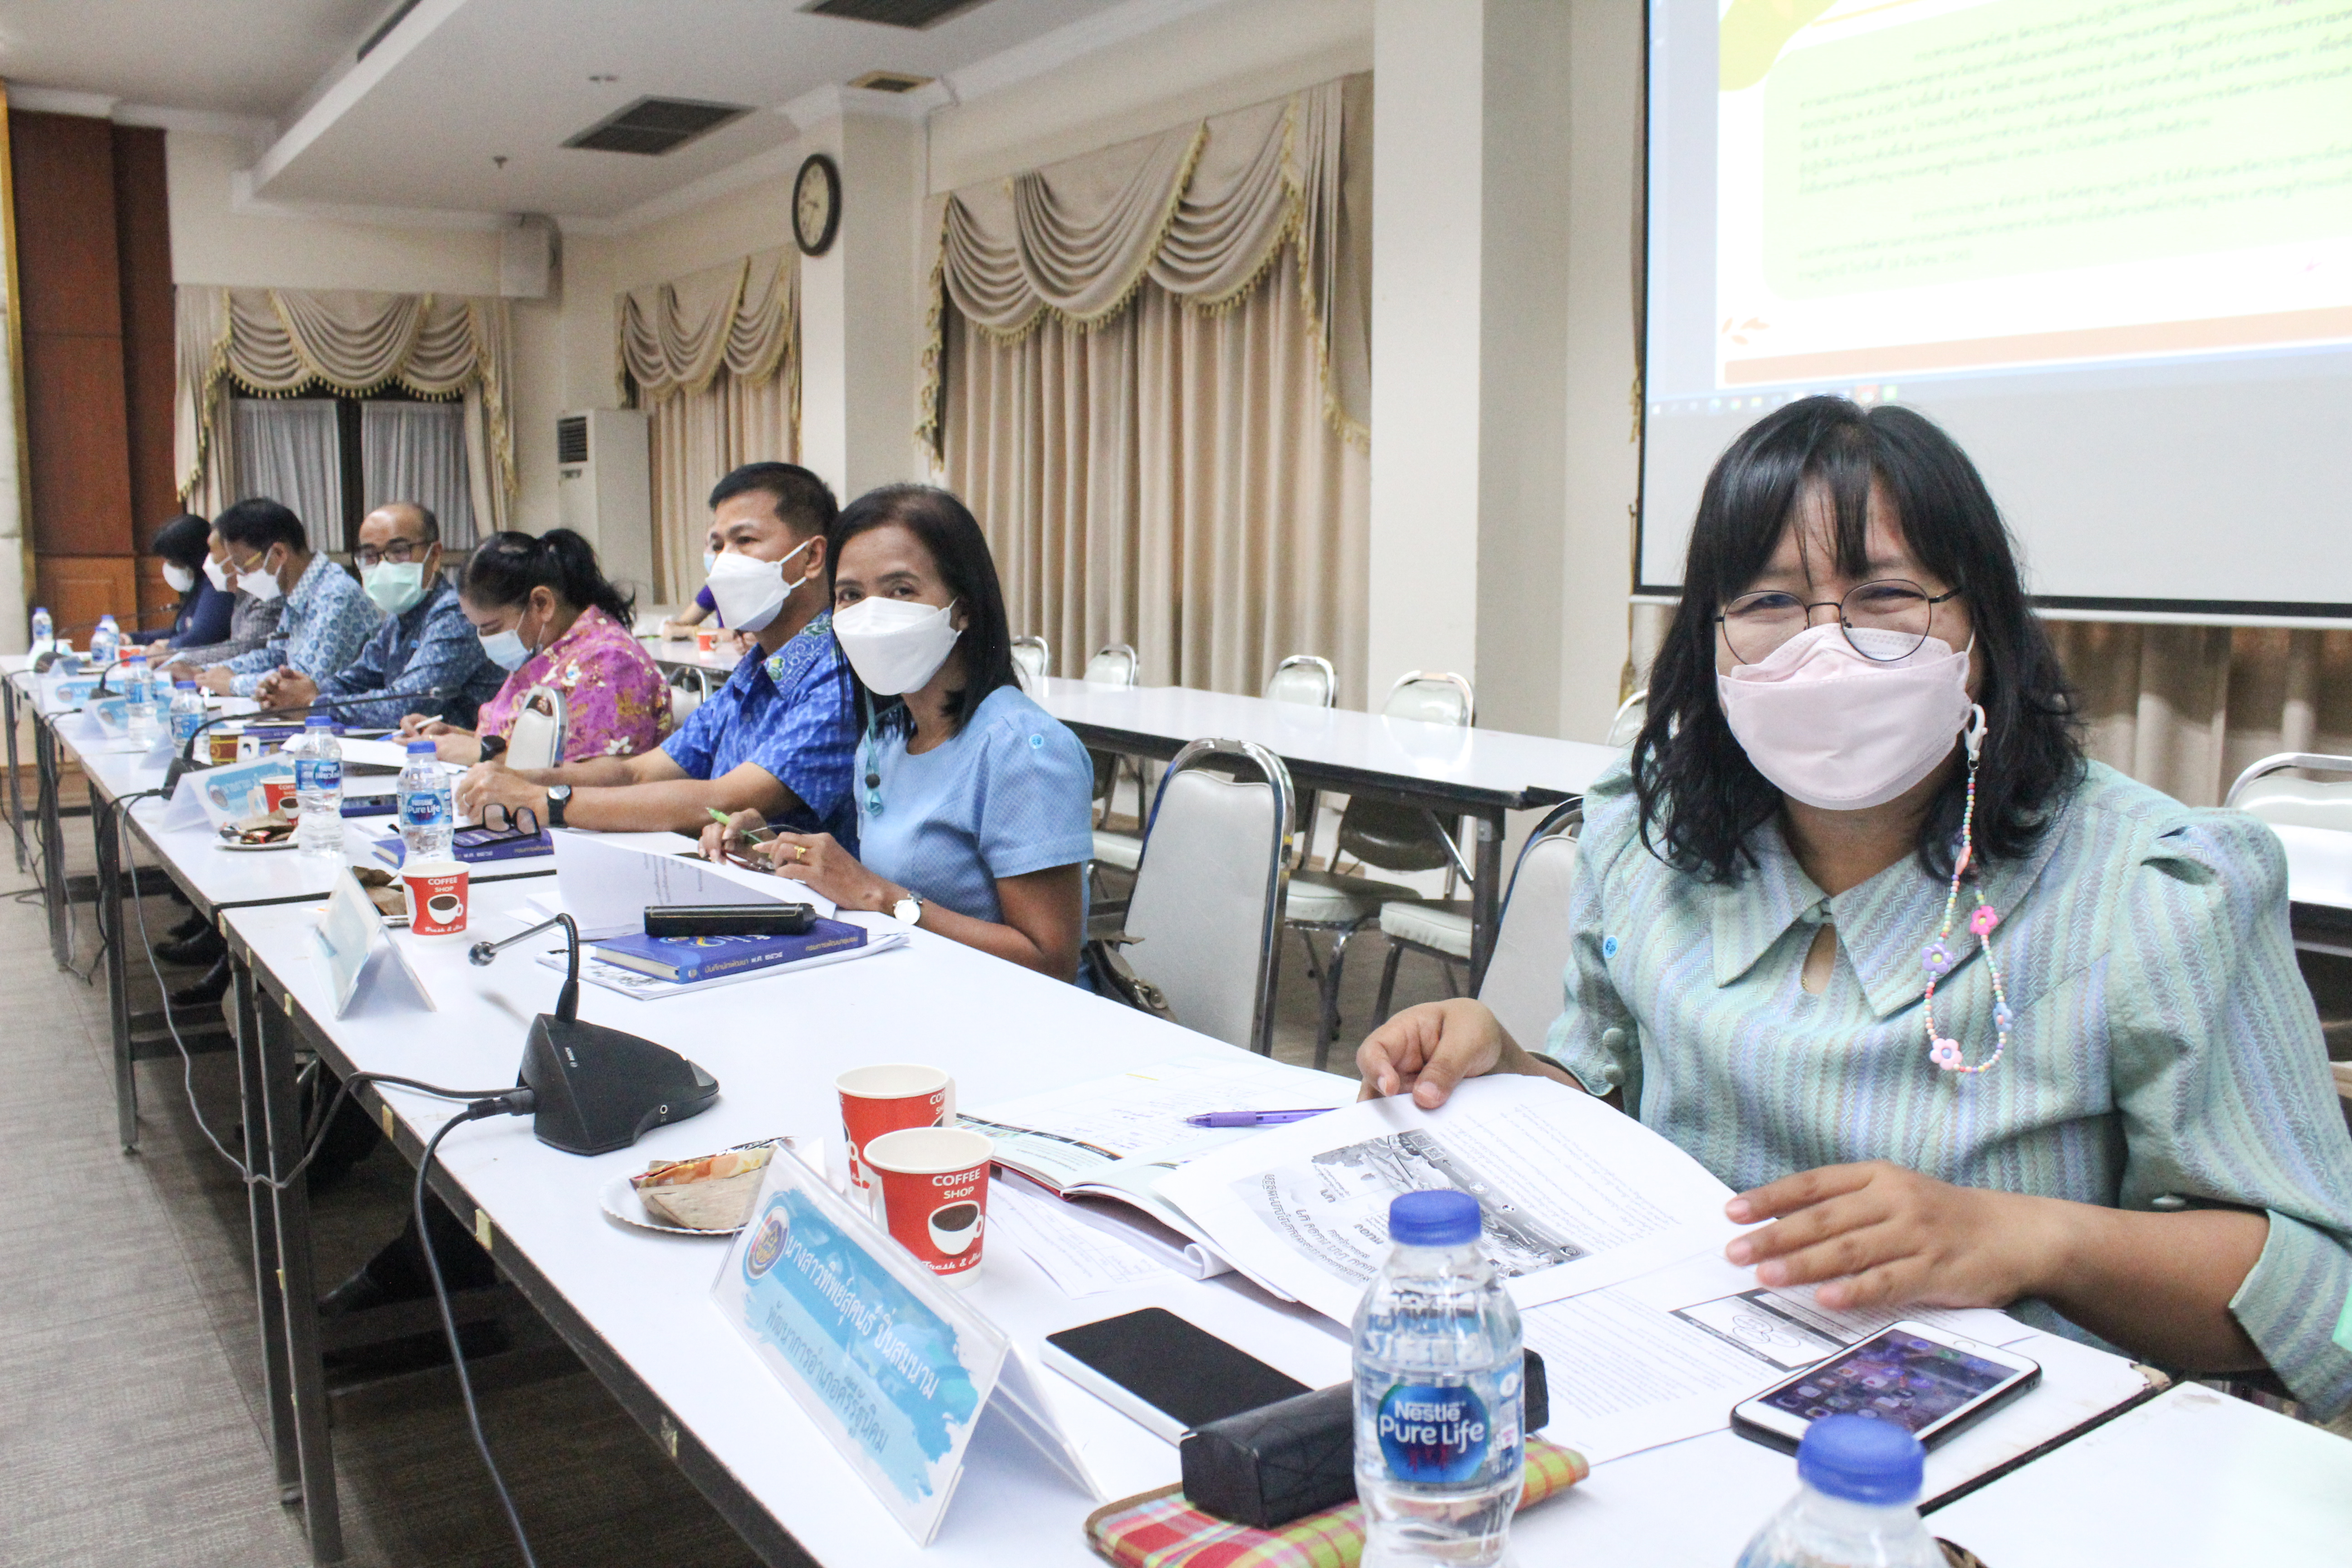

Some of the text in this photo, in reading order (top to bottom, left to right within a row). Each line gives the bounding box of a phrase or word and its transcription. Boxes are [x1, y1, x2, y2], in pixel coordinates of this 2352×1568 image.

[427, 877, 458, 885] COFFEE
[932, 1168, 980, 1186] COFFEE
[943, 1186, 975, 1199] SHOP
[959, 1258, 967, 1267] &
[1379, 1414, 1437, 1446] Pure
[1442, 1419, 1485, 1454] Life
